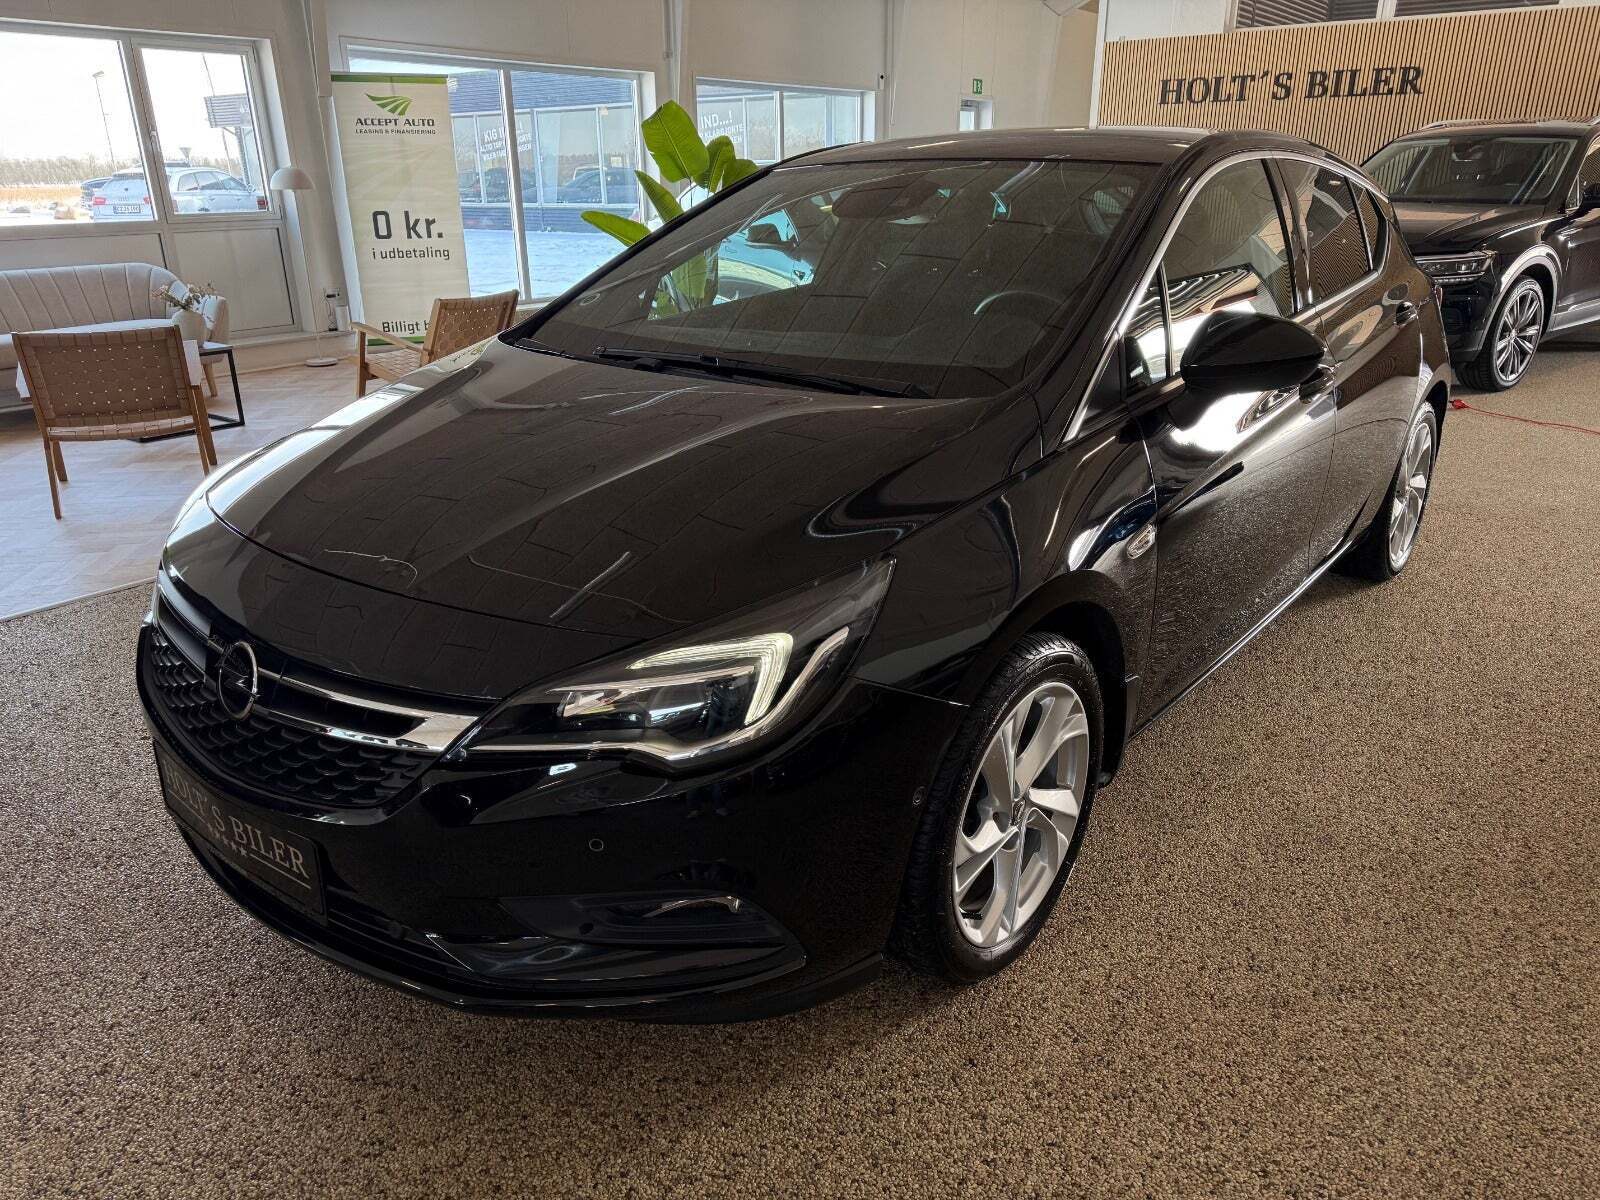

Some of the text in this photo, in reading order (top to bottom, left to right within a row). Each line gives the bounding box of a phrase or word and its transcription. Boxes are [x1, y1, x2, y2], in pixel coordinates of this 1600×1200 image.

[1304, 66, 1424, 99] BILER
[355, 117, 435, 127] ACCEPT AUTO
[404, 210, 444, 240] kr.
[372, 246, 450, 261] i udbetaling
[382, 320, 420, 335] Billigt
[228, 814, 311, 880] BILER
